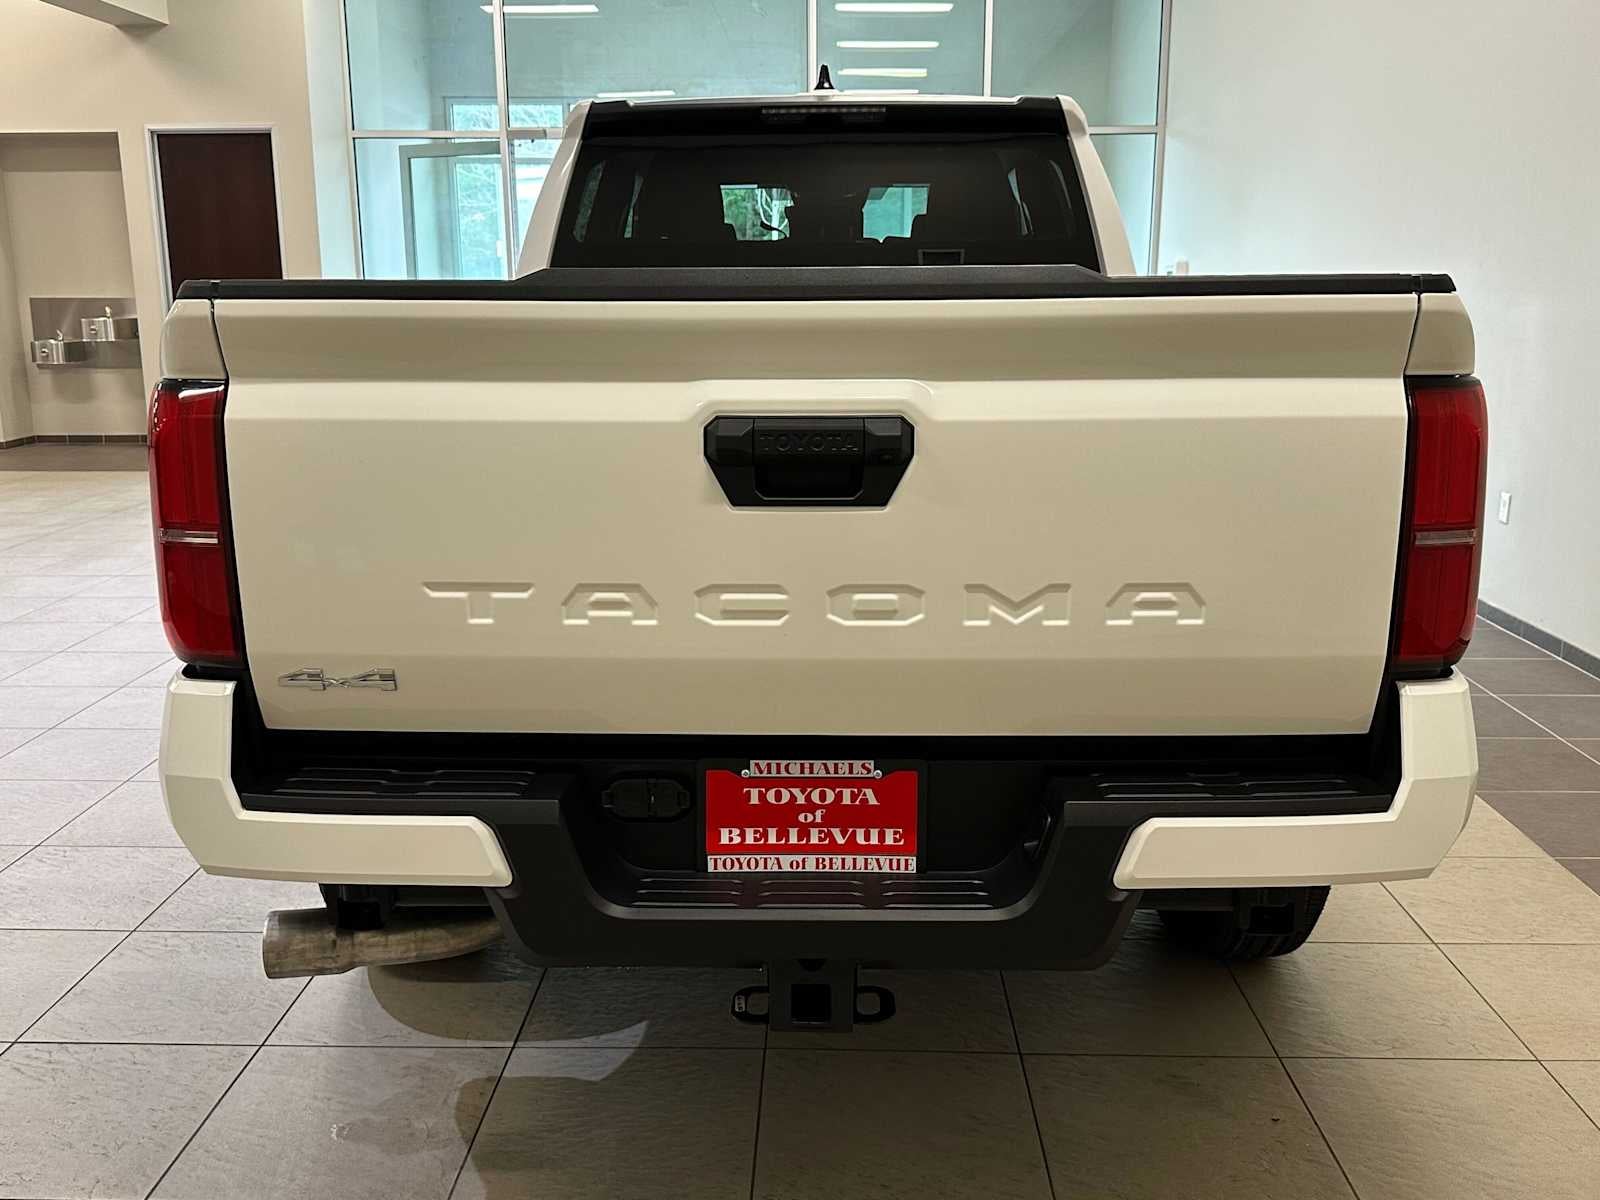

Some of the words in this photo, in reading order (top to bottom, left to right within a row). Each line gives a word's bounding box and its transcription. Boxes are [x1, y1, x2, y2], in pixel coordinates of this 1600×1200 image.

[758, 432, 859, 453] TOYOTA
[421, 580, 1207, 627] TACOMA
[753, 761, 874, 776] MICHAELS
[743, 787, 881, 806] TOYOTA
[797, 808, 826, 823] of
[718, 827, 905, 846] BELLEVUE
[709, 856, 783, 871] TOYOTA
[789, 857, 809, 871] of
[814, 857, 915, 872] BELLEVUE
